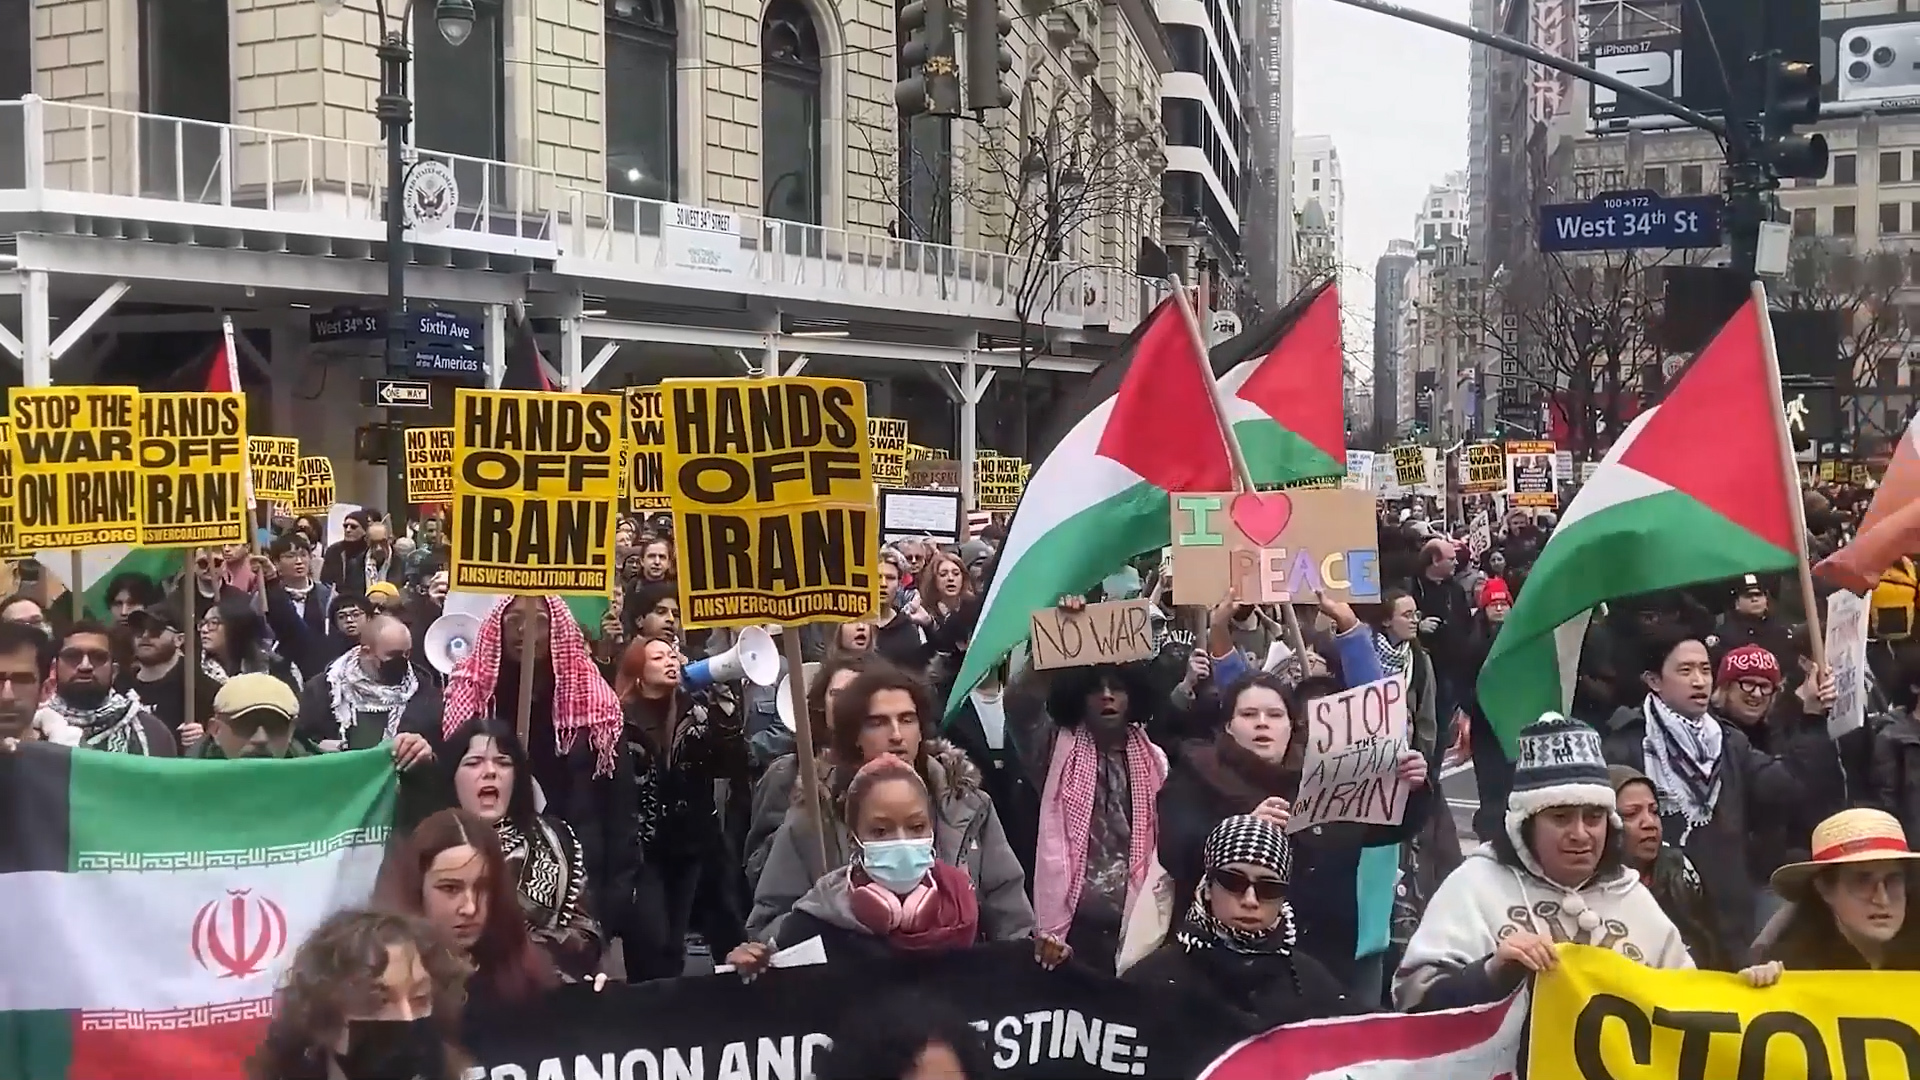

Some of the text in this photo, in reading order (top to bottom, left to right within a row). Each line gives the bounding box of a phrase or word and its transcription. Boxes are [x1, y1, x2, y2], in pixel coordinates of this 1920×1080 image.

[1603, 41, 1651, 54] iPhone 17
[1604, 198, 1649, 208] 100 172
[712, 213, 730, 231] STREET
[1556, 210, 1698, 239] West 34th St
[316, 320, 343, 335] West
[365, 317, 376, 330] St
[420, 318, 470, 339] Sixth Ave
[434, 354, 478, 371] Americas
[386, 389, 423, 398] ONE WAY
[15, 395, 132, 429] STOP THE
[139, 397, 239, 437] HANDS
[673, 384, 857, 454] HANDS
[465, 395, 611, 452] HANDS
[868, 420, 905, 438] O NEW
[17, 430, 133, 464] WAR
[249, 440, 295, 455] STOP THE
[408, 431, 425, 449] NO
[877, 438, 904, 450] WAR
[139, 438, 239, 468] OFF
[249, 453, 295, 468] WAR
[409, 450, 454, 463] US WA
[875, 453, 903, 464] THE
[1393, 446, 1421, 459] HANDS
[1469, 447, 1484, 456] STOP
[1469, 456, 1500, 465] WAR
[298, 458, 330, 474] ANDS
[886, 464, 903, 476] EAST
[981, 460, 1020, 472] NO NEW
[1395, 457, 1423, 466] OFF
[266, 470, 295, 491] IRAN!
[410, 466, 451, 478] IN TH
[462, 451, 611, 492] OFF
[634, 452, 663, 492] ON
[678, 451, 861, 504] OFF
[981, 474, 1019, 483] US WAR
[1396, 464, 1425, 481] IRAN!
[1469, 467, 1481, 481] ON
[19, 472, 57, 527] ON
[67, 470, 136, 524] IRAN!
[141, 472, 239, 524] RAN!
[981, 486, 1020, 494] IN THE
[460, 495, 609, 565] IRAN!
[1178, 498, 1223, 546] I
[20, 529, 136, 548] PSLWEB.ORG
[685, 509, 868, 591] IRAN!
[460, 566, 604, 587] ANSWERCOALITION.ORG
[1230, 547, 1378, 601] PEACE
[694, 592, 867, 618] ANSWERCOALITION.ORG
[1032, 606, 1151, 665] NO WAR
[1316, 680, 1400, 754] STOP
[1304, 738, 1402, 788] ATTACK
[1294, 777, 1400, 822] ON IRAN
